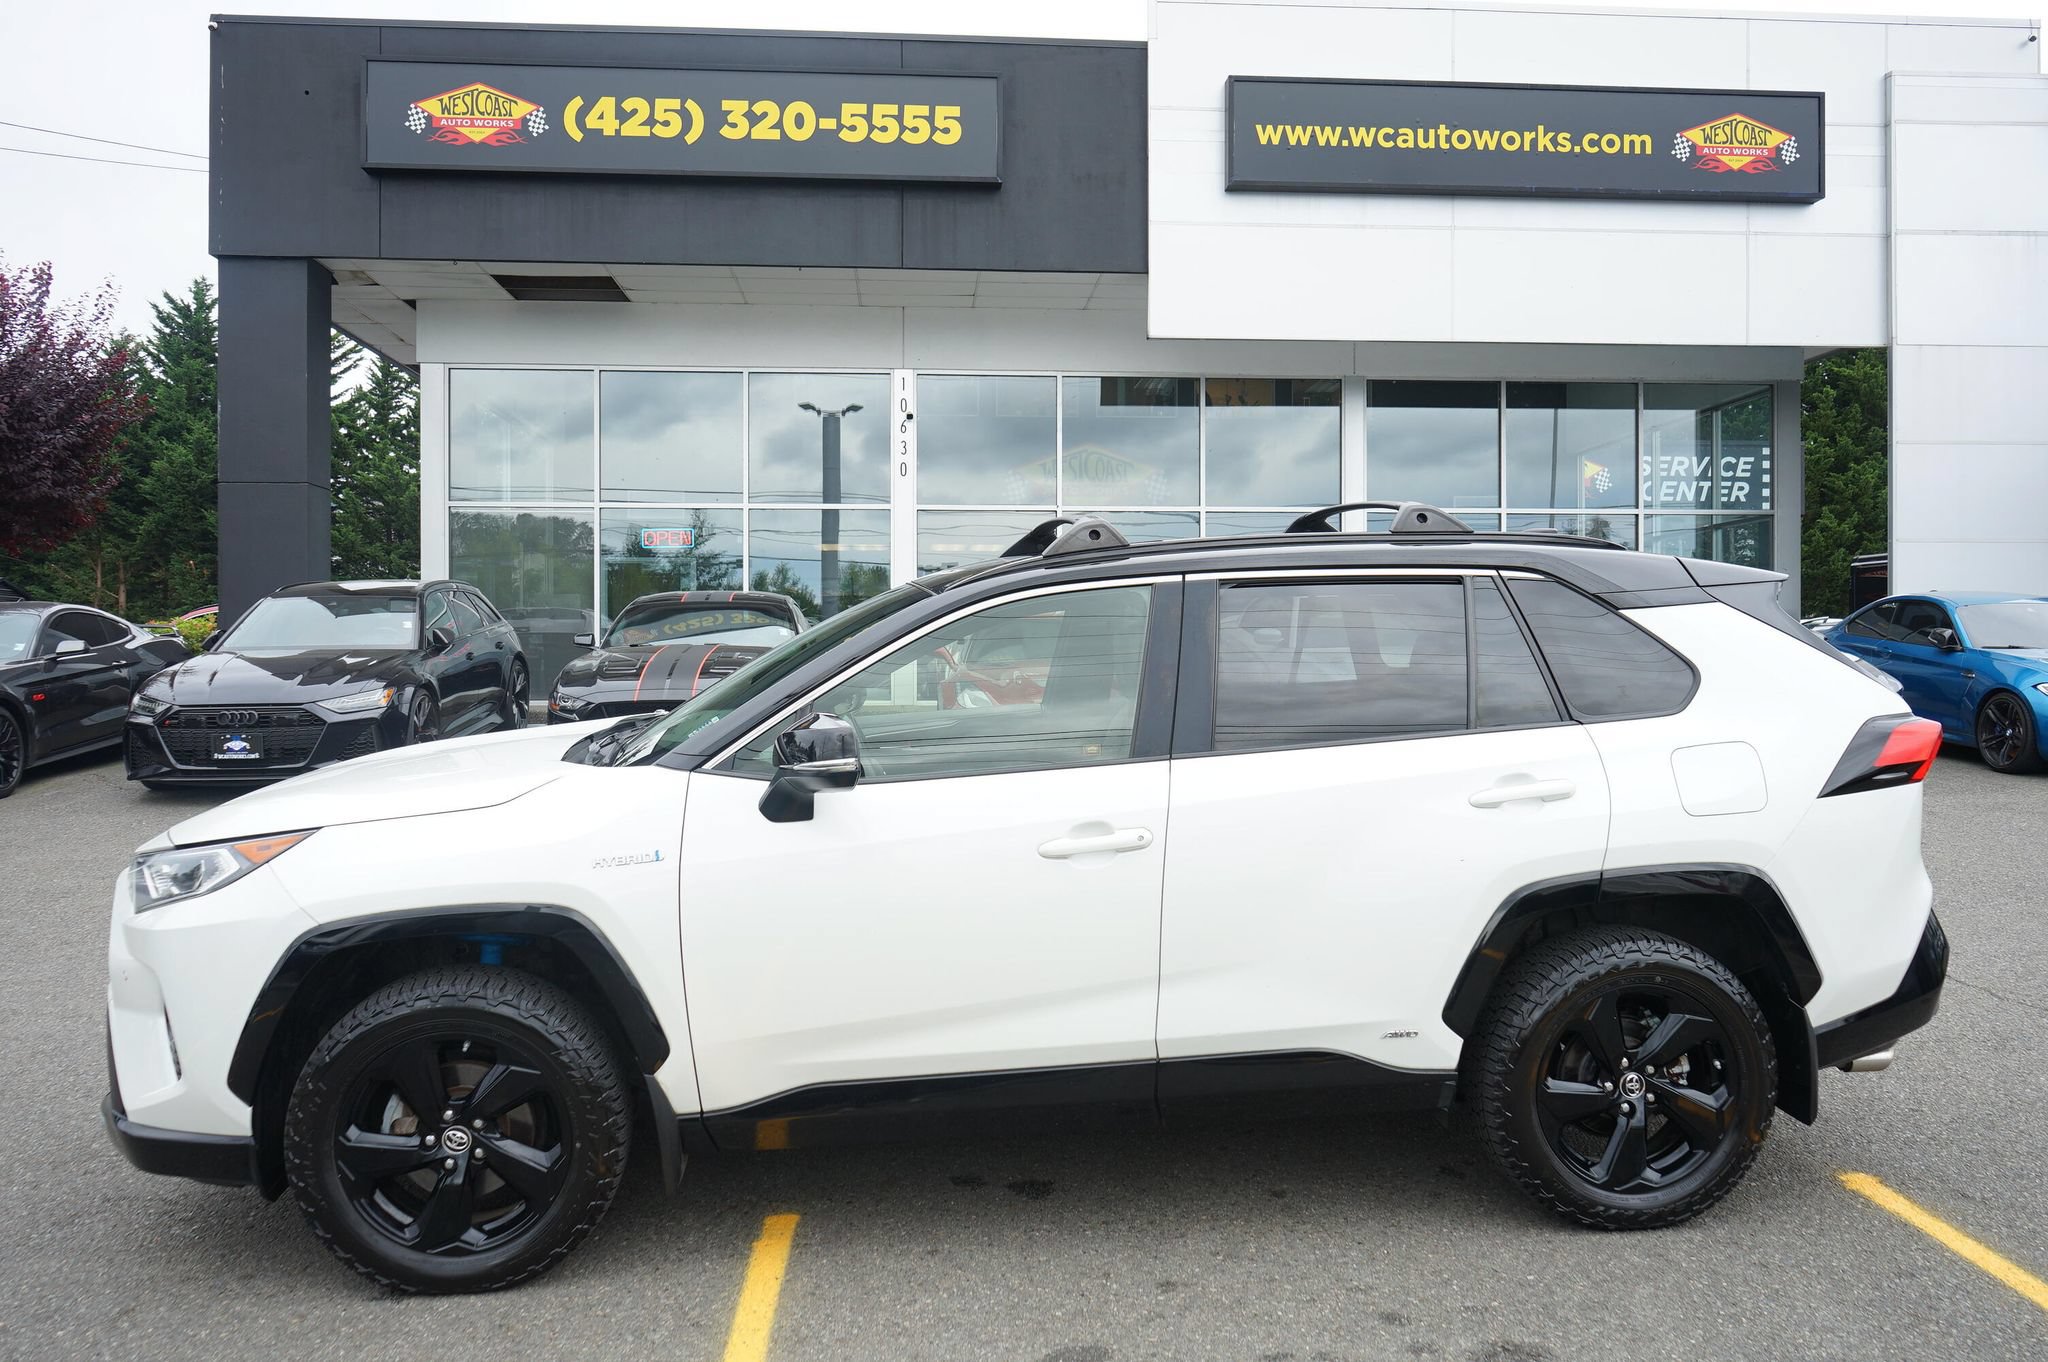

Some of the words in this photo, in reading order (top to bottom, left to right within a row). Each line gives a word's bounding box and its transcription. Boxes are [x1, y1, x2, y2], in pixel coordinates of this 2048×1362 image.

[440, 118, 471, 127] AUTO
[474, 119, 514, 128] WORKS
[564, 95, 704, 144] (425)
[720, 99, 962, 146] 320-5555
[1255, 123, 1653, 155] www.wcautoworks.com
[1702, 146, 1731, 155] AUTO
[1732, 147, 1769, 156] WORKS
[900, 377, 908, 477] 10630
[1643, 455, 1755, 477] SERVCE
[1643, 480, 1750, 502] CENTER
[644, 530, 692, 546] OPEN
[592, 853, 653, 869] HYBRID
[1380, 1030, 1419, 1039] AWD
